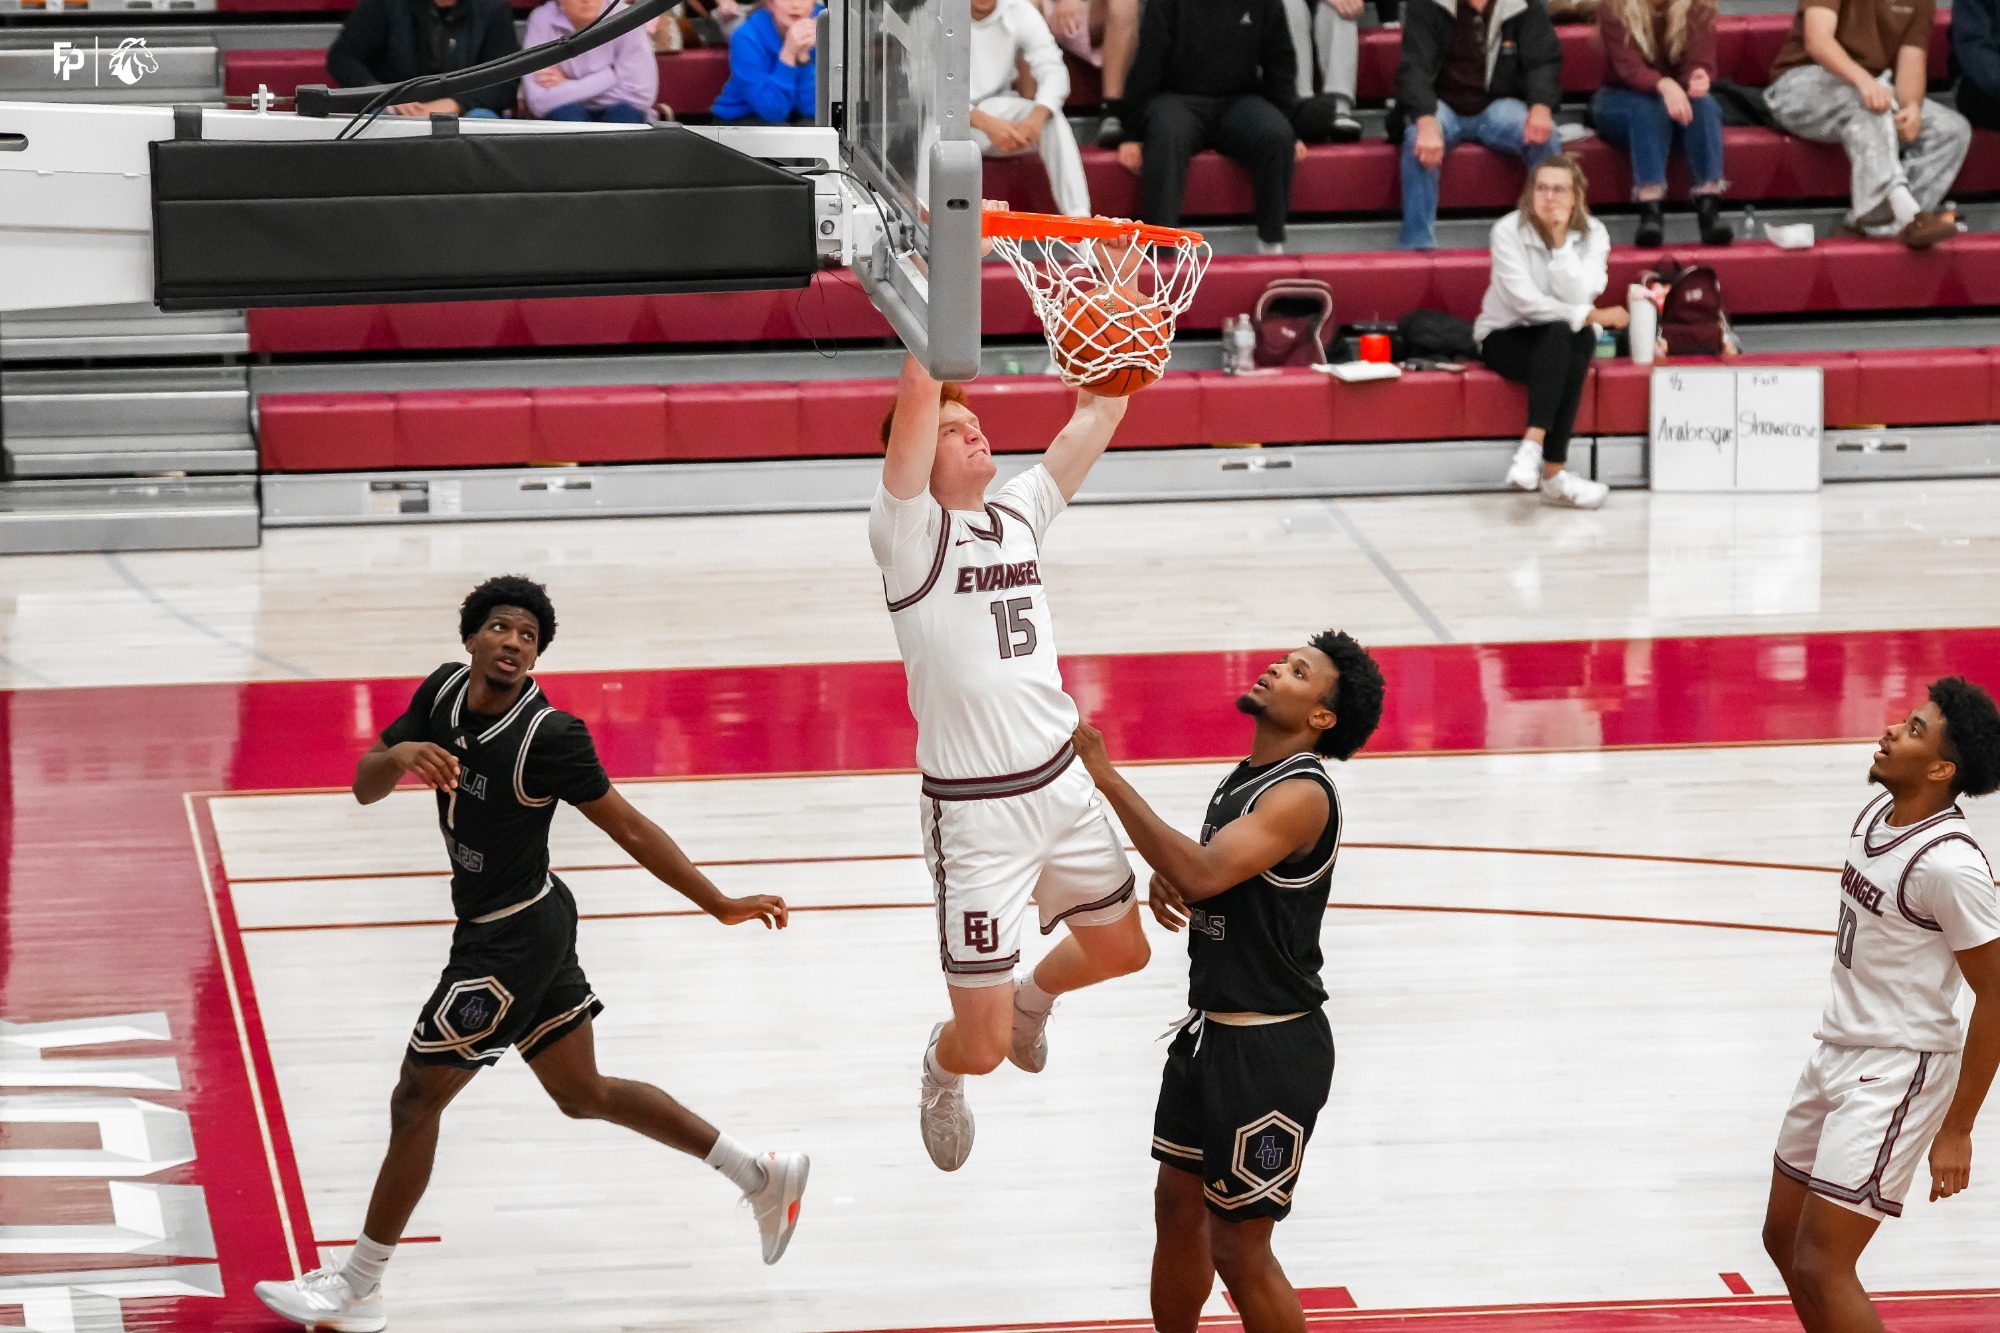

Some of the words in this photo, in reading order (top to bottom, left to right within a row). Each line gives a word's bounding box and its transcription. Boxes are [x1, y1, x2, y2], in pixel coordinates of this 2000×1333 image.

[953, 559, 1042, 594] EVANGEL
[990, 596, 1038, 660] 15
[963, 910, 999, 954] EU
